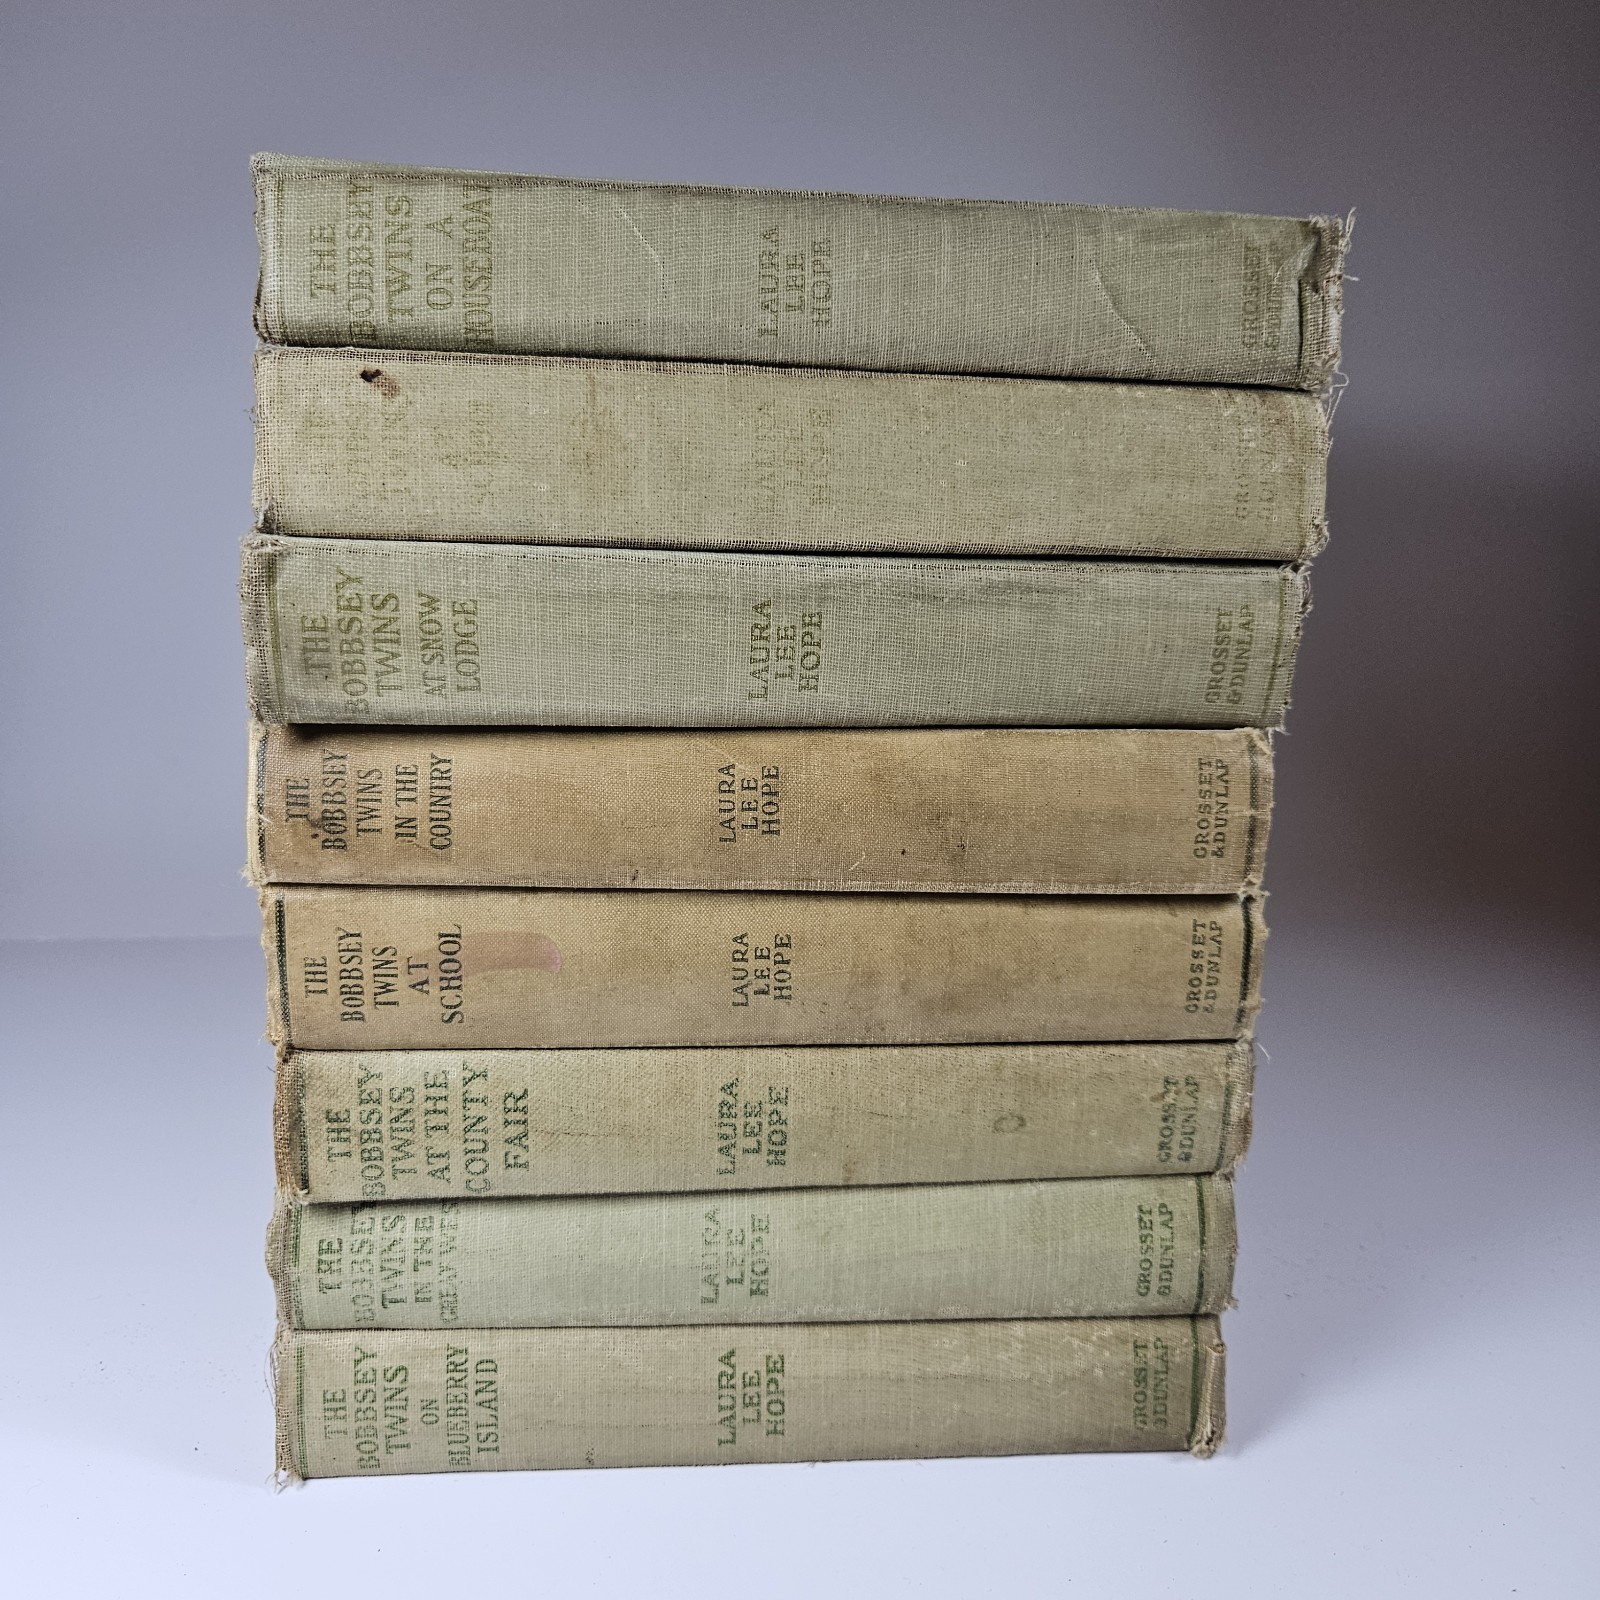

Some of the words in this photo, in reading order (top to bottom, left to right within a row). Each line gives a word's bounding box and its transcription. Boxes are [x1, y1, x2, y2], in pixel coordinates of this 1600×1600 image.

[310, 224, 336, 298] THE
[348, 181, 376, 341] BOBBSEY
[385, 195, 414, 323] TWINS
[426, 214, 453, 239] A
[462, 183, 494, 345] HOUSEBOAT
[426, 263, 454, 311] ON
[758, 227, 779, 337] LAURA
[786, 253, 805, 312] LEE
[812, 240, 831, 327] HOPE
[302, 614, 330, 674] THE
[336, 566, 370, 714] BOBBSEY
[371, 592, 402, 697] TWINS
[418, 591, 445, 665] SNOW
[453, 599, 481, 693] LODGE
[749, 599, 771, 700] LAURA
[775, 625, 796, 679] LEE
[799, 612, 822, 692] HOPE
[1205, 607, 1233, 703] GROSSET
[423, 671, 447, 698] AT
[285, 778, 310, 823] THE
[322, 748, 348, 850] BOBBSEY
[356, 768, 382, 837] TWINS
[395, 764, 418, 805] THE
[429, 753, 453, 850] COUNTRY
[718, 763, 737, 843] LAURA
[741, 777, 758, 830] LEE
[761, 765, 780, 836] HOPE
[1193, 758, 1212, 859] GROSSET
[395, 815, 417, 840] IN
[304, 955, 328, 998] THE
[337, 926, 366, 1023] BOBBSEY
[371, 945, 400, 1010] TWINS
[407, 956, 430, 995] AT
[438, 923, 464, 1024] SCHOOL
[732, 932, 750, 1007] LAURA
[754, 946, 771, 996] LEE
[774, 933, 792, 1001] HOPE
[1185, 919, 1206, 1014] GROSSET
[325, 1108, 352, 1163] THE
[357, 1062, 386, 1197] BOBBSEY
[389, 1086, 417, 1181] TWINS
[424, 1069, 450, 1138] THE
[462, 1062, 491, 1194] COUNTY
[503, 1088, 529, 1172] FAIR
[717, 1077, 739, 1176] LAURA
[742, 1100, 763, 1155] LEE
[767, 1086, 789, 1166] HOPE
[1157, 1075, 1179, 1163] GROSST
[427, 1146, 450, 1183] AT
[317, 1238, 343, 1294] THE
[380, 1215, 407, 1309] TWINS
[413, 1215, 434, 1272] THE
[701, 1205, 720, 1304] LAURA
[726, 1229, 745, 1285] LEE
[750, 1213, 769, 1297] HOPE
[1136, 1204, 1154, 1297] GROSSET
[414, 1281, 433, 1304] IN
[323, 1388, 348, 1439] THE
[354, 1346, 380, 1469] BOBBSEY
[383, 1365, 411, 1454] TWINS
[420, 1398, 440, 1426] ON
[446, 1343, 471, 1466] BLUEBERRY
[475, 1358, 499, 1454] ISLAND
[718, 1348, 736, 1446] LAURA
[742, 1370, 761, 1426] LEE
[766, 1354, 785, 1437] HOPE
